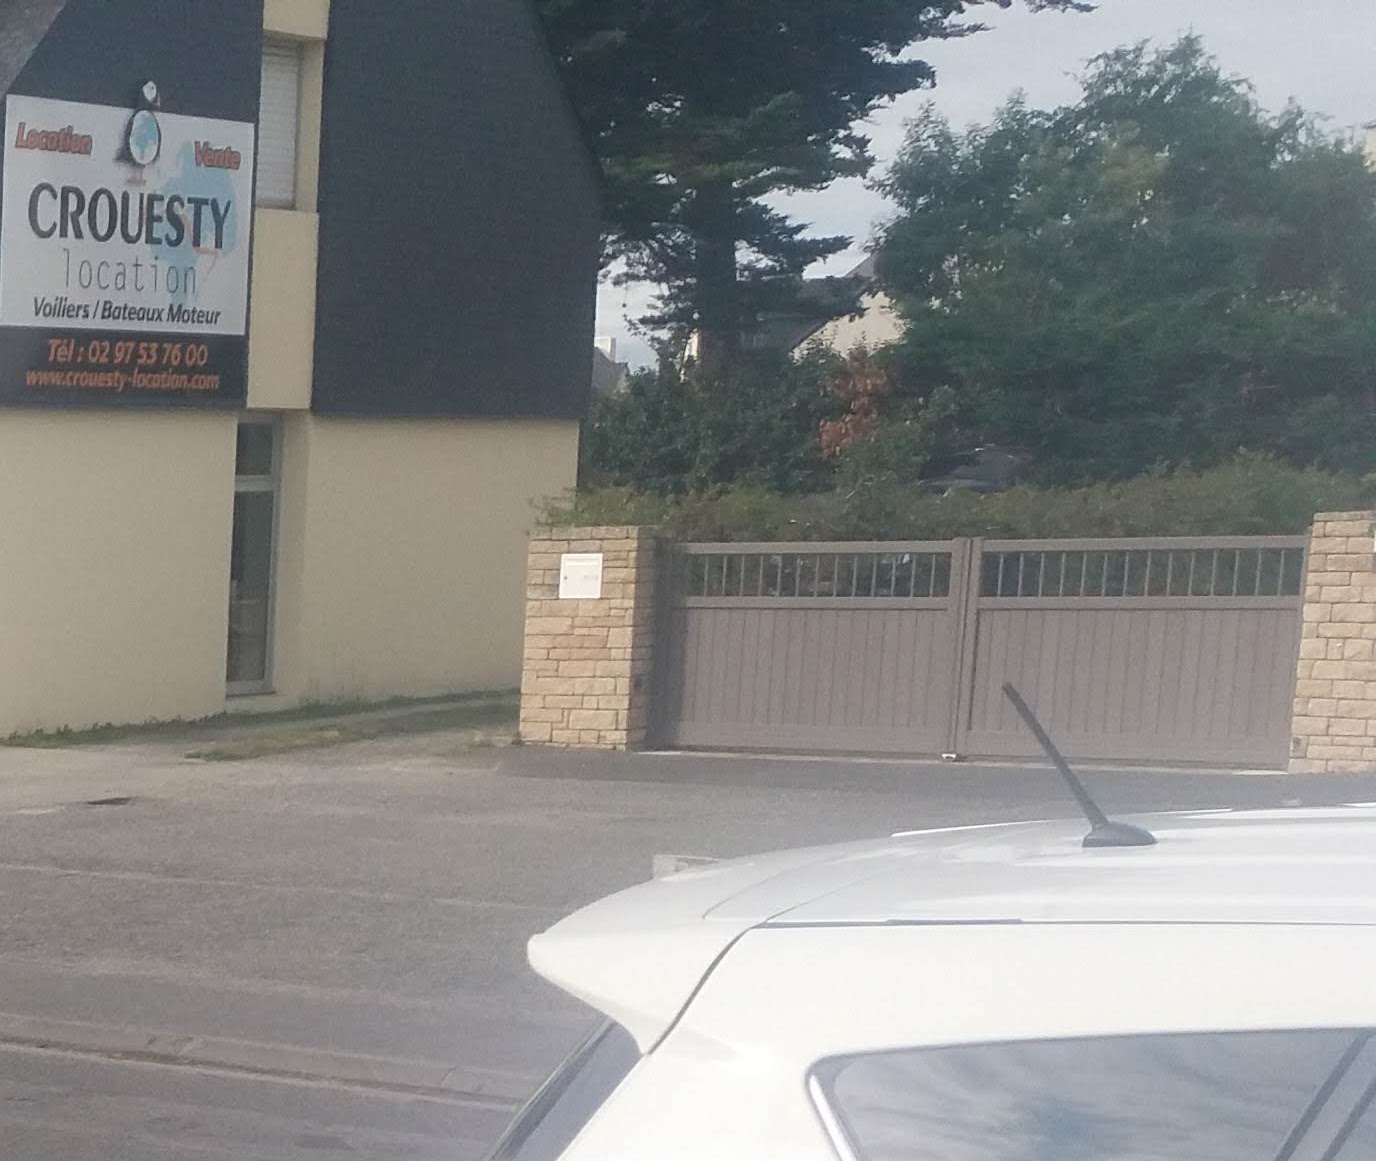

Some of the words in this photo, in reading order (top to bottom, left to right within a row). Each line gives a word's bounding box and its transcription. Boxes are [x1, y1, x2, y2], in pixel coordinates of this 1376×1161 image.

[15, 122, 93, 155] Location
[194, 140, 241, 170] Vente
[28, 182, 232, 249] CROUESTY
[62, 248, 196, 293] location
[34, 297, 90, 320] Voiliers
[101, 300, 164, 322] Bateaux
[166, 304, 221, 325] Moteur
[88, 342, 109, 363] 02
[113, 343, 135, 364] 97
[138, 343, 158, 365] 53
[162, 344, 182, 366] 76
[185, 344, 209, 366] 00
[25, 366, 220, 391] www.crouesty-location.com
